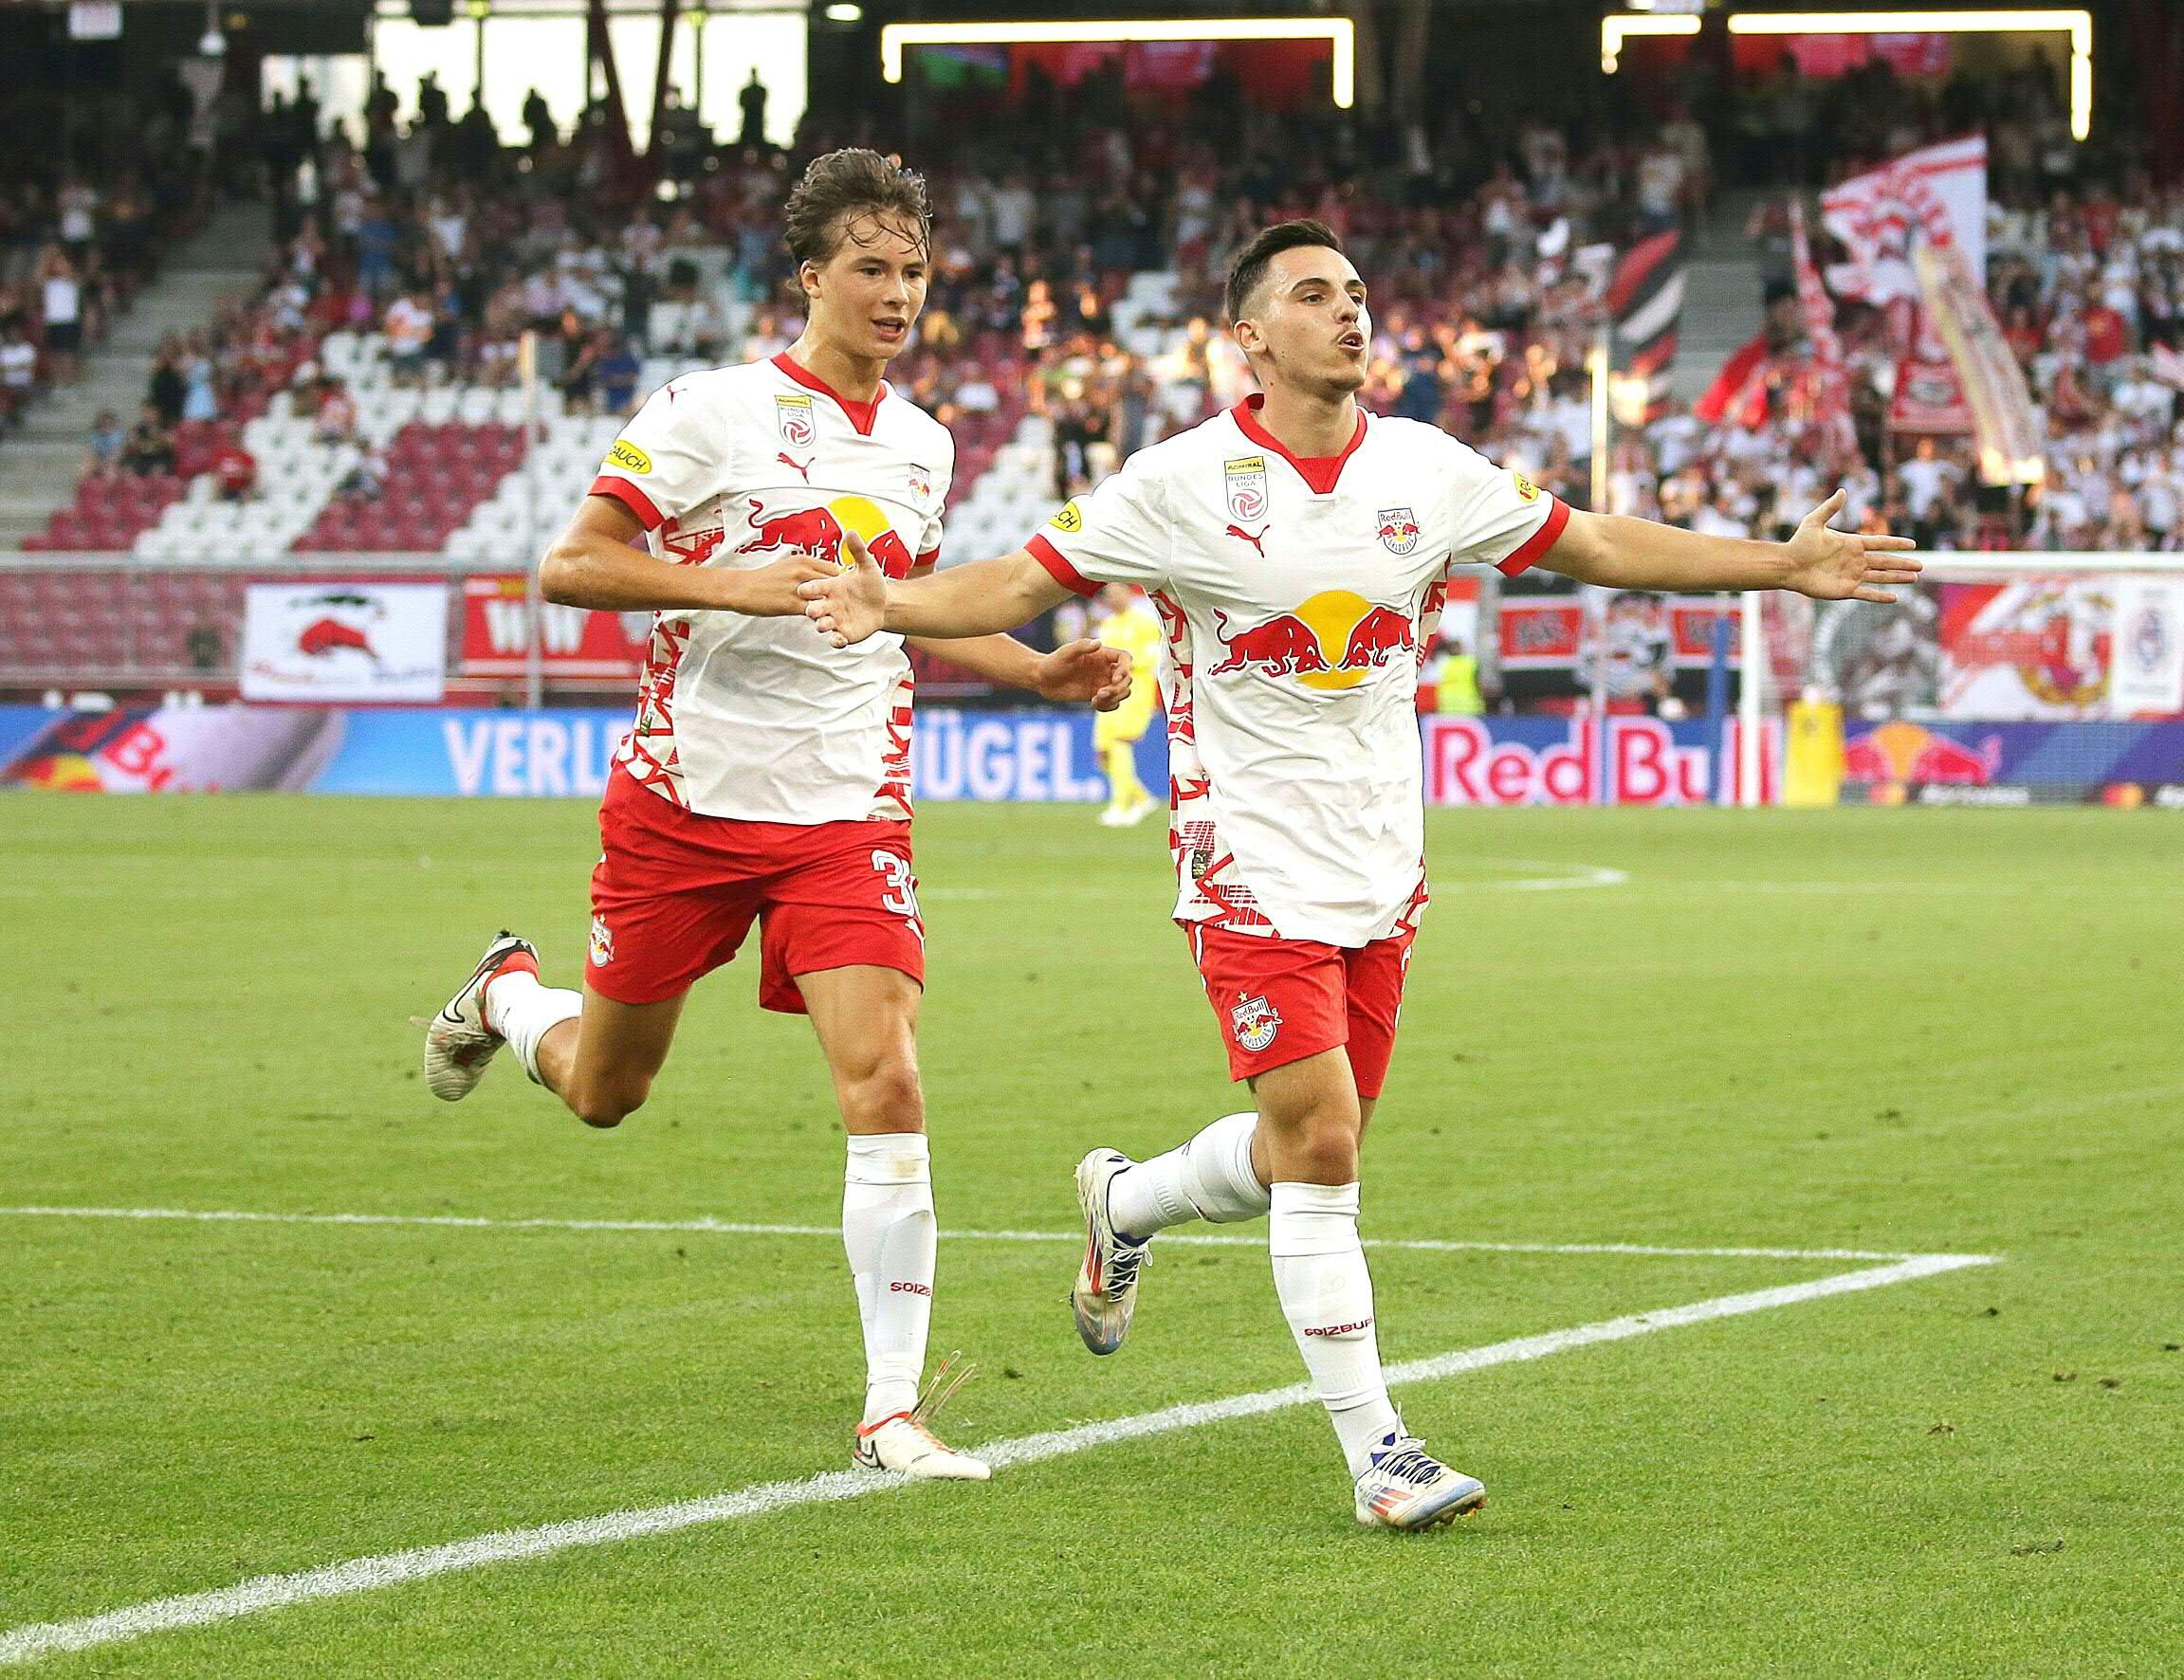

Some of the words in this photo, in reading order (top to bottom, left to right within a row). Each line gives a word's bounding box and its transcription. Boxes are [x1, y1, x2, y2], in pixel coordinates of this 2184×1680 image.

[609, 446, 647, 471] AUCH
[1055, 510, 1078, 529] CH
[924, 710, 1106, 798] ÜGEL.
